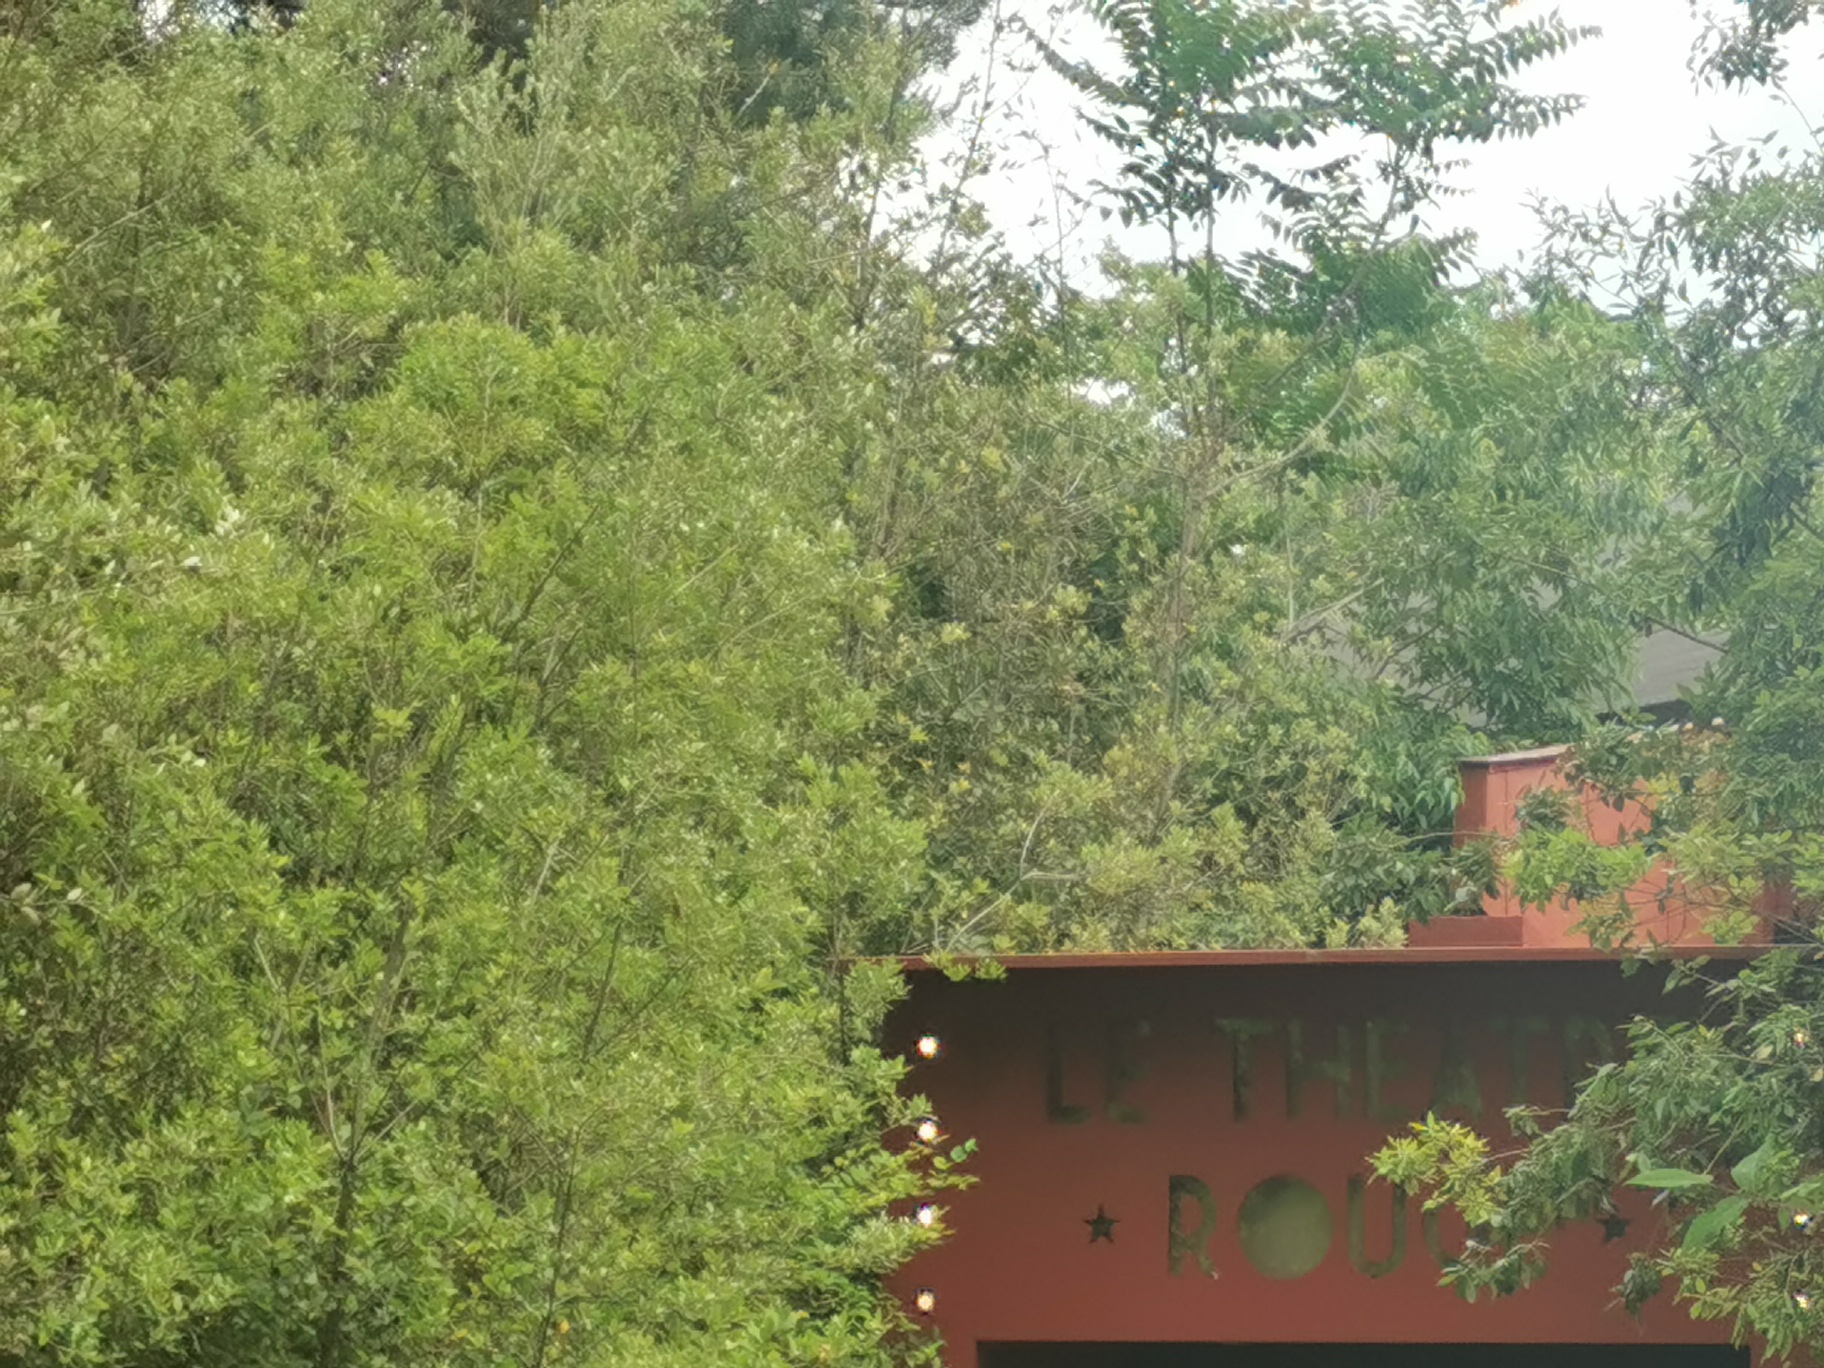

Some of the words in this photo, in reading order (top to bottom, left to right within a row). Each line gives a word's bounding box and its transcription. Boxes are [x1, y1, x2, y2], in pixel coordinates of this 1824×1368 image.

[1045, 1014, 1149, 1123] LE
[1212, 1012, 1690, 1123] THEATR
[1168, 1171, 1530, 1280] ROU
